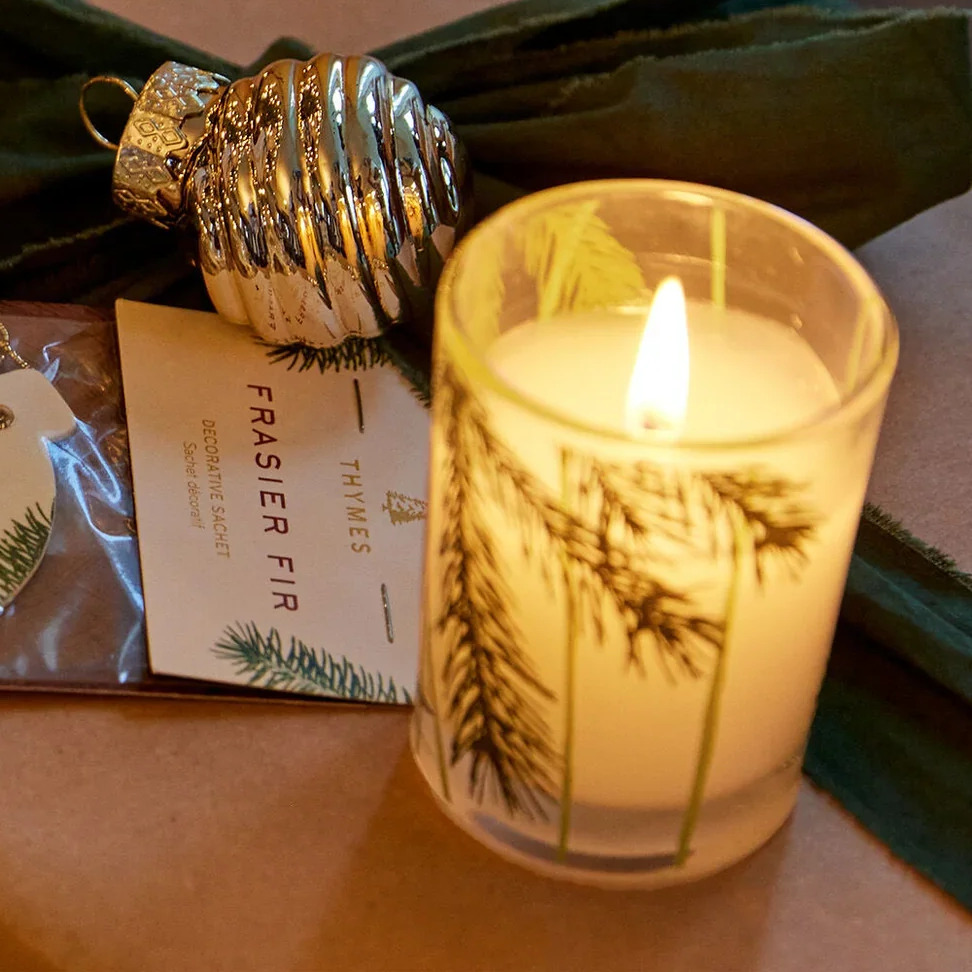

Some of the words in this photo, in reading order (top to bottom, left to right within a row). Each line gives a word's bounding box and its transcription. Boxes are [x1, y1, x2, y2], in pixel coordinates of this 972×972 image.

[183, 441, 198, 479] Sachet
[202, 418, 224, 501] DECORATIVE
[247, 384, 289, 535] FRASIER
[211, 505, 230, 560] SACHET
[340, 459, 372, 555] THYMES
[267, 554, 299, 612] FIR
